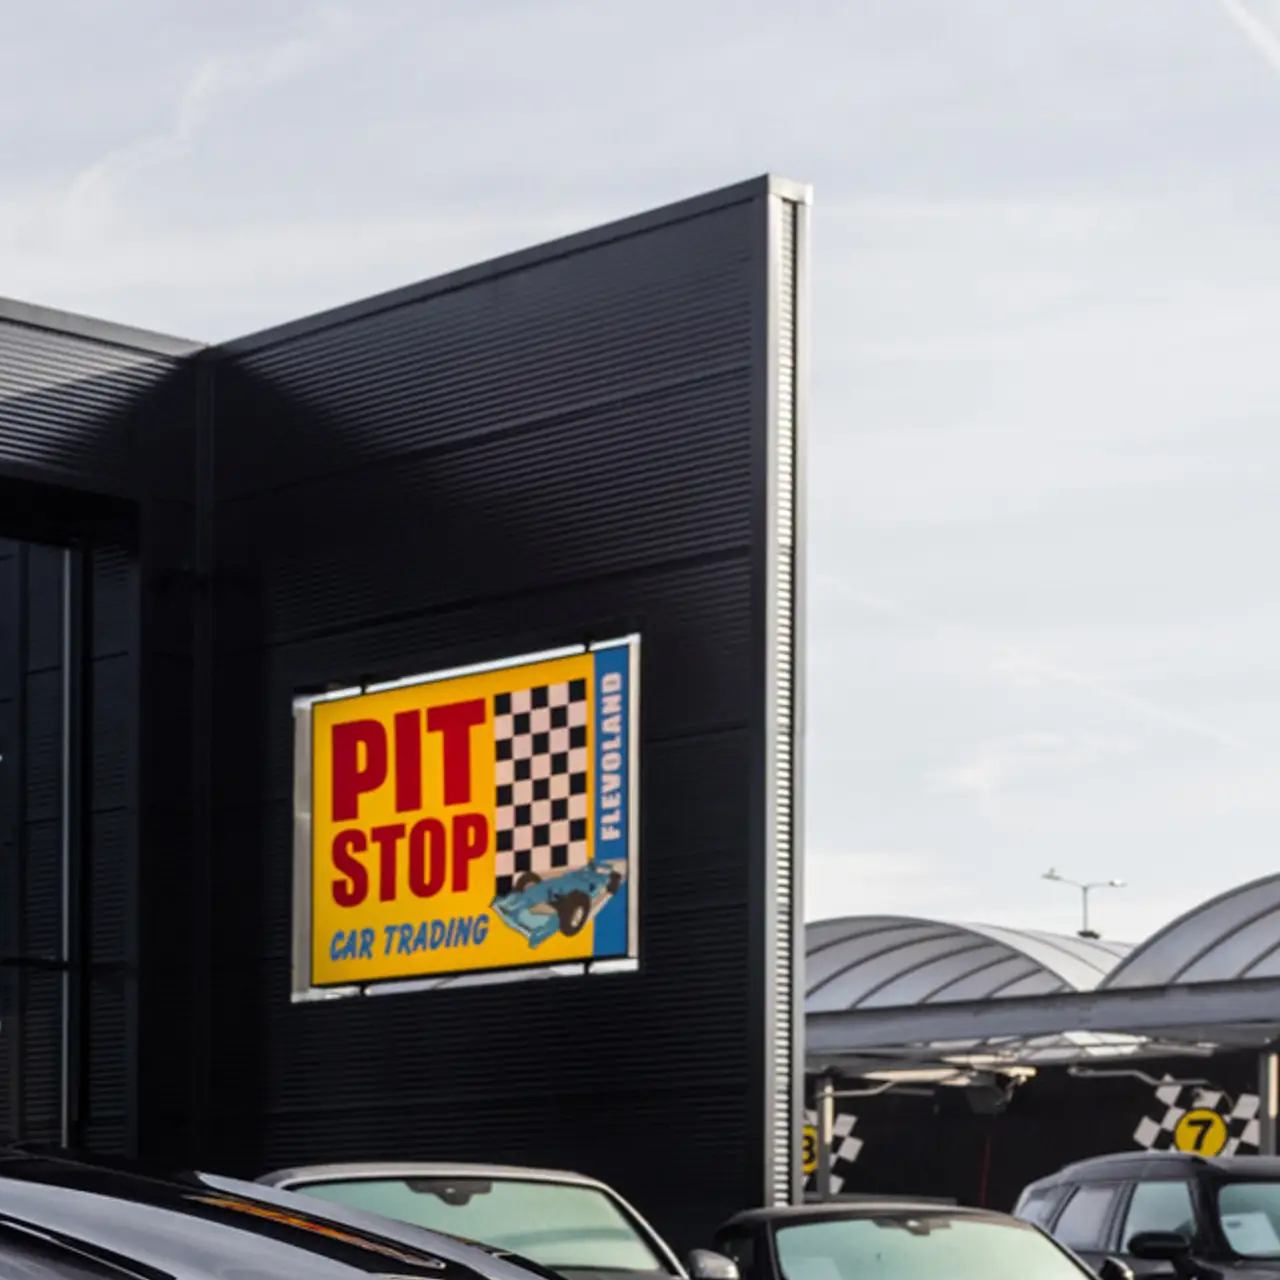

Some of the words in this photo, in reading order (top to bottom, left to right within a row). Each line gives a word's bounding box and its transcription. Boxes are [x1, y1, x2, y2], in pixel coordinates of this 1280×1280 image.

[331, 698, 486, 822] PIT
[600, 671, 623, 841] FLEVOLAND
[331, 813, 489, 908] STOP
[329, 927, 376, 961] CAR
[384, 914, 490, 957] TRADING
[1186, 1117, 1215, 1152] 7
